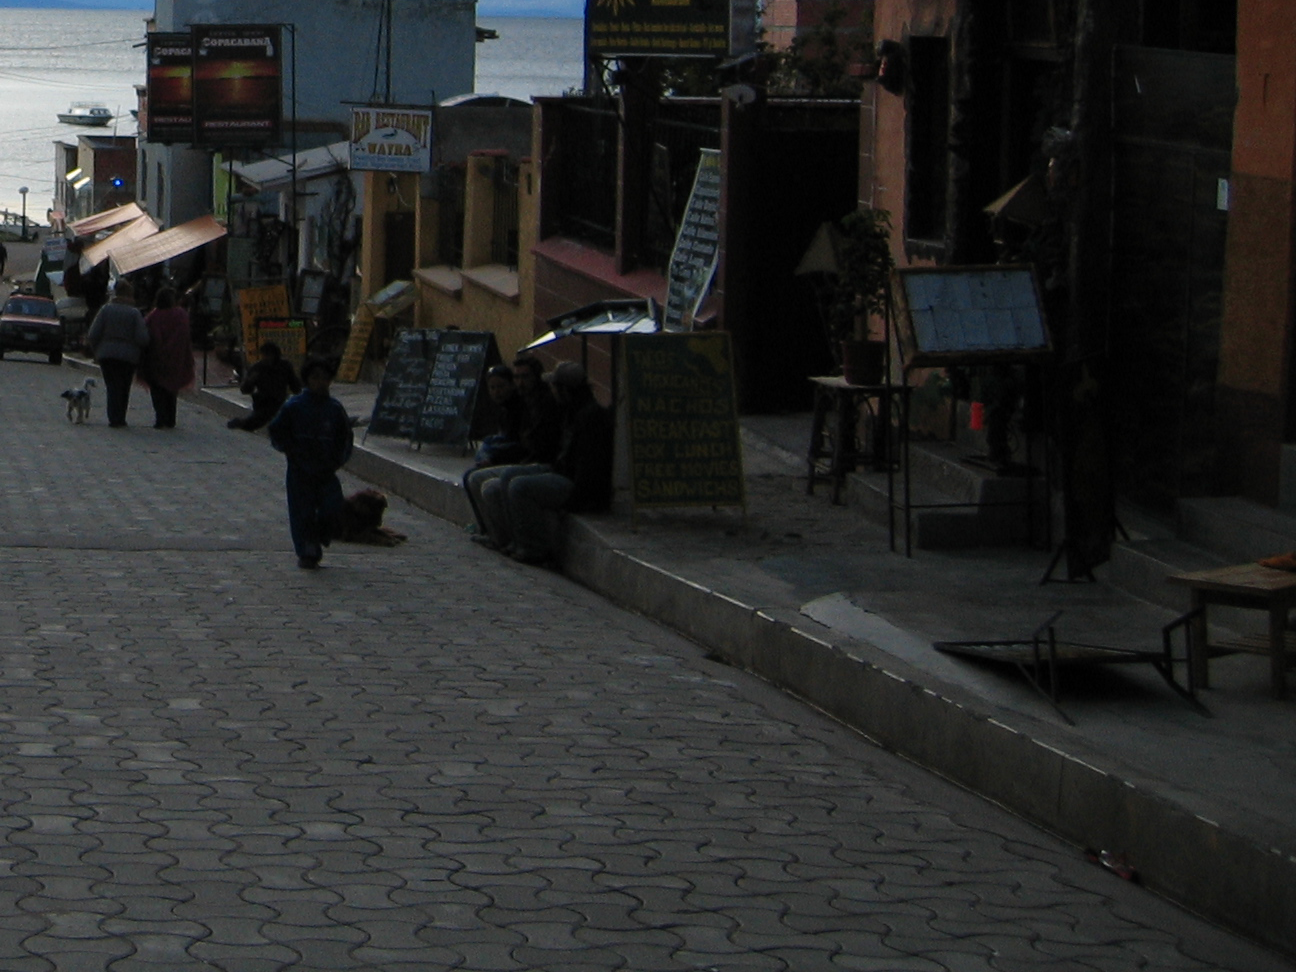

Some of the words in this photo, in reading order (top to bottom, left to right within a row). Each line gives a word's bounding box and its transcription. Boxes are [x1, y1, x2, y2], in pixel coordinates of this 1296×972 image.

[203, 36, 271, 47] COPACABANA
[636, 397, 730, 416] NACHOS
[632, 419, 736, 441] BREAKFAST
[634, 443, 666, 459] BOX
[674, 441, 734, 458] LUNCH
[634, 462, 675, 477] FREE
[679, 460, 739, 477] MOVIES
